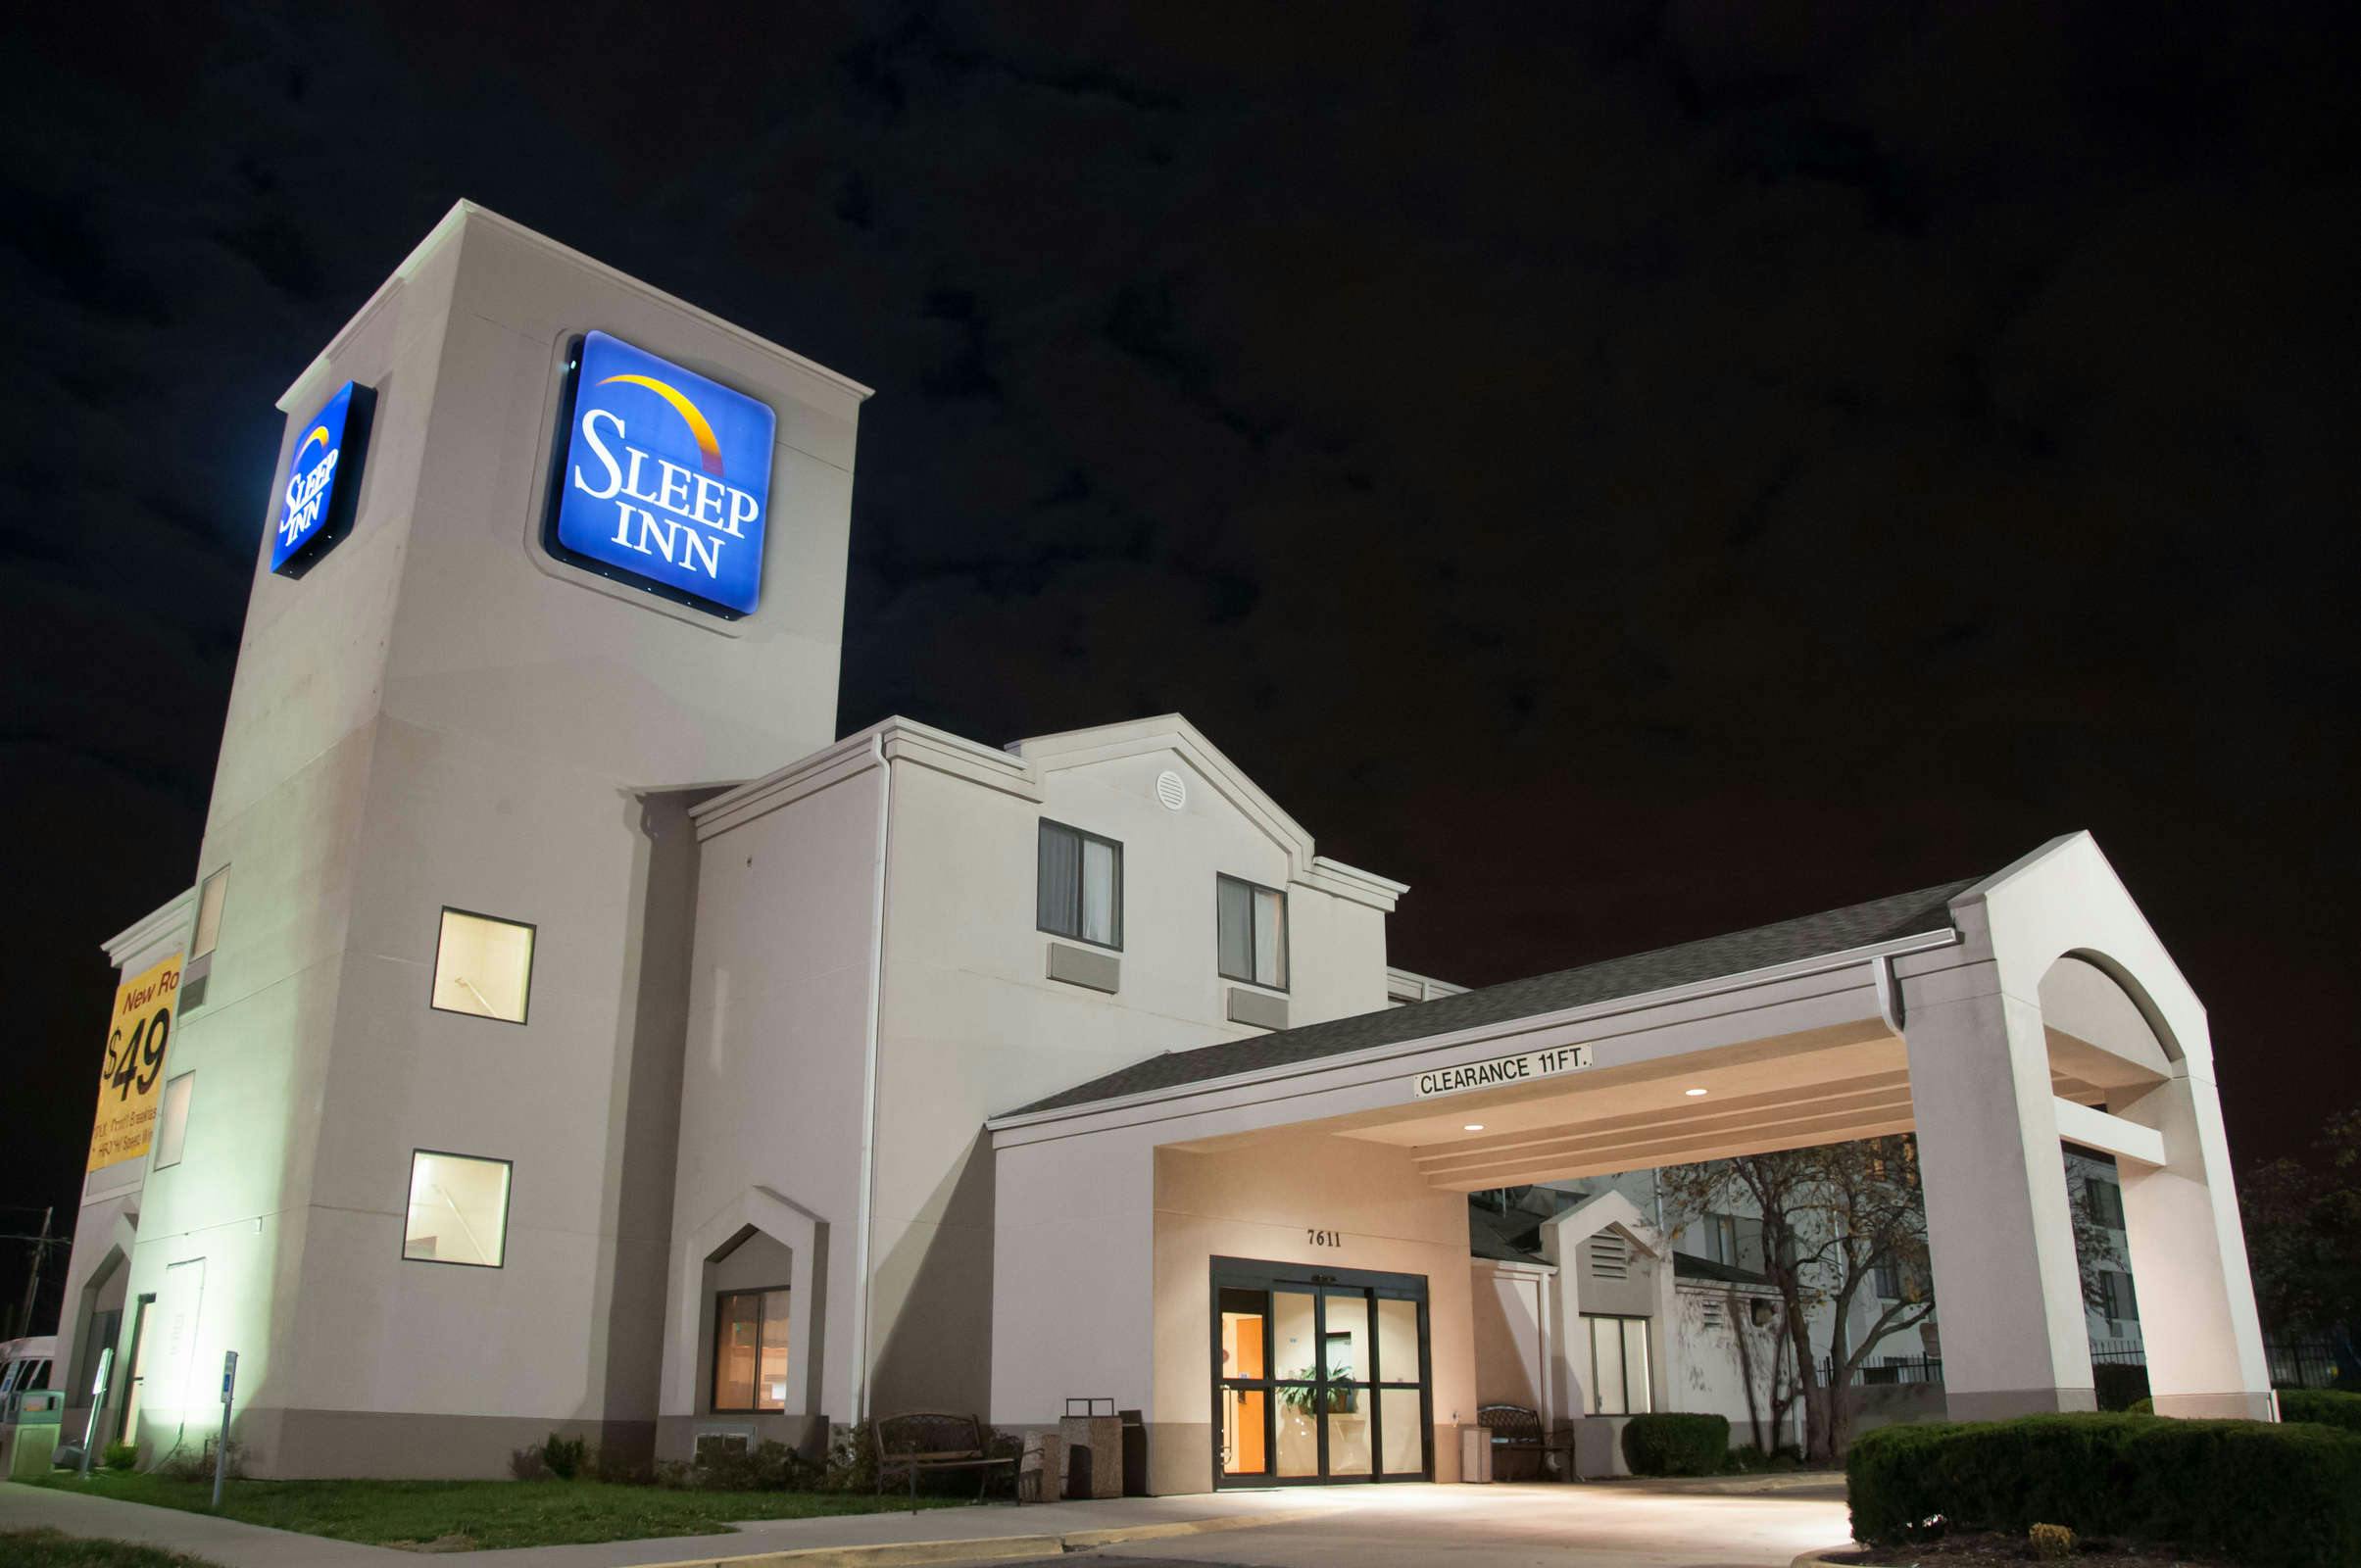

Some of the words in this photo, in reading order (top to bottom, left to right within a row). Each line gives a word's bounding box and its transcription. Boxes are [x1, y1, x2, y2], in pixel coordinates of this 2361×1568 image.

[279, 449, 339, 532] SLEEP
[574, 409, 759, 538] SLEEP
[285, 492, 323, 547] INN
[611, 500, 725, 579] INN
[123, 983, 155, 1015] New
[104, 1007, 171, 1102] $49
[1420, 1057, 1530, 1095] CLEARANCE
[1306, 1229, 1342, 1248] 7611
